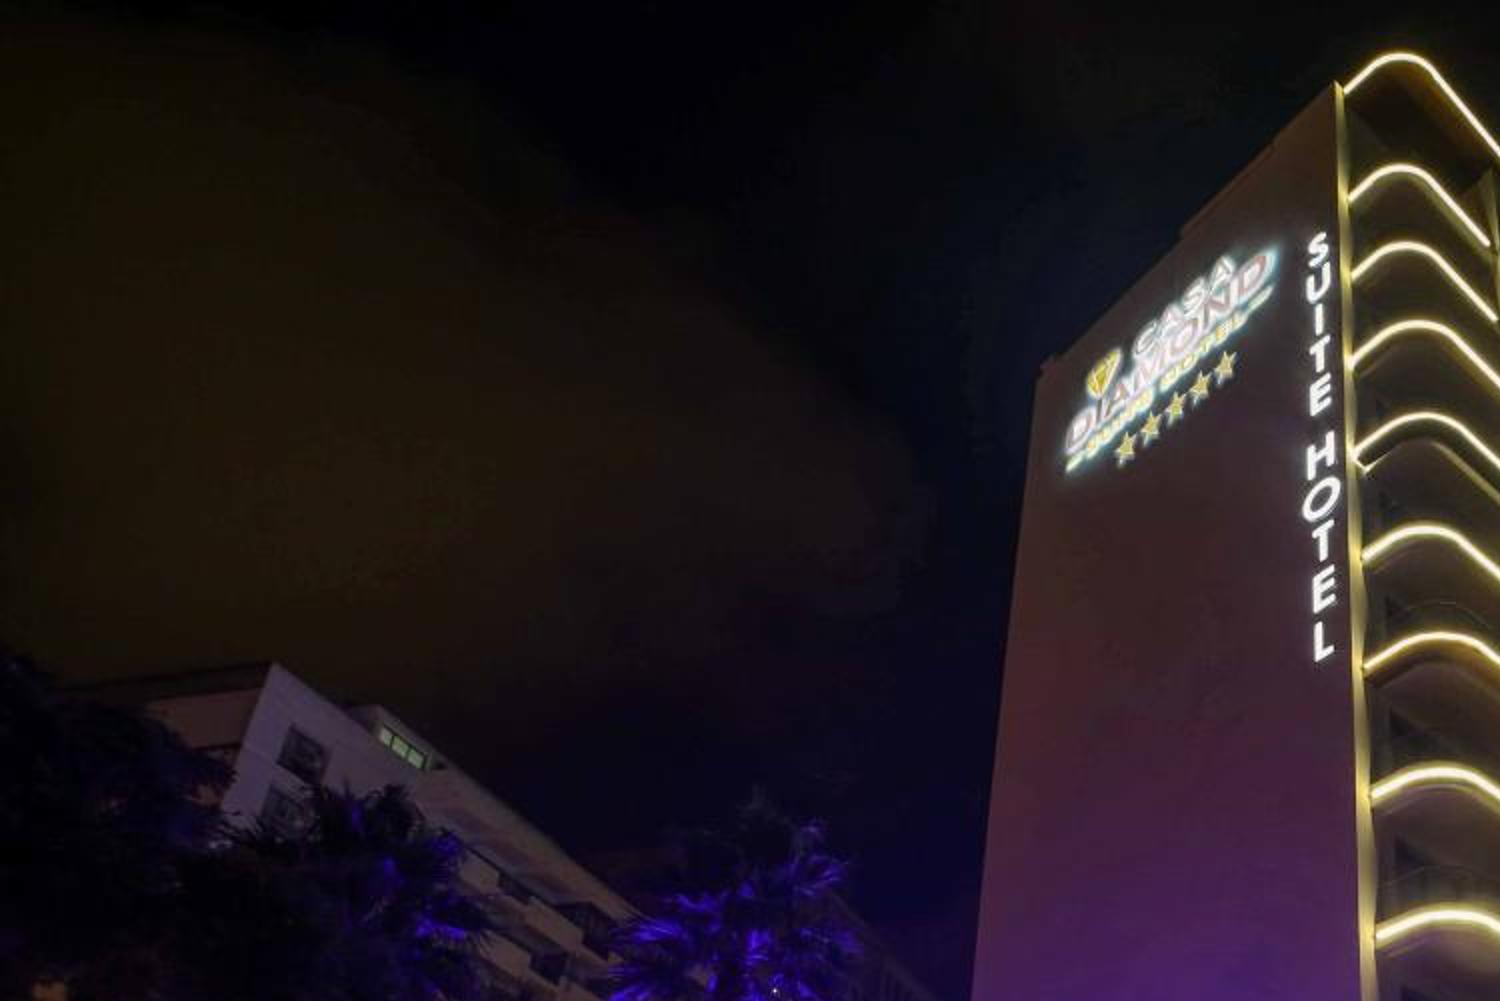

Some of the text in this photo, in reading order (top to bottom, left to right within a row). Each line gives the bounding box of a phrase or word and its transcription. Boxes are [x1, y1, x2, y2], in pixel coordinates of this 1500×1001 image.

[1066, 251, 1277, 455] DIAMOND
[1131, 255, 1236, 357] CASA
[1303, 232, 1341, 662] SUITE HOTEL
